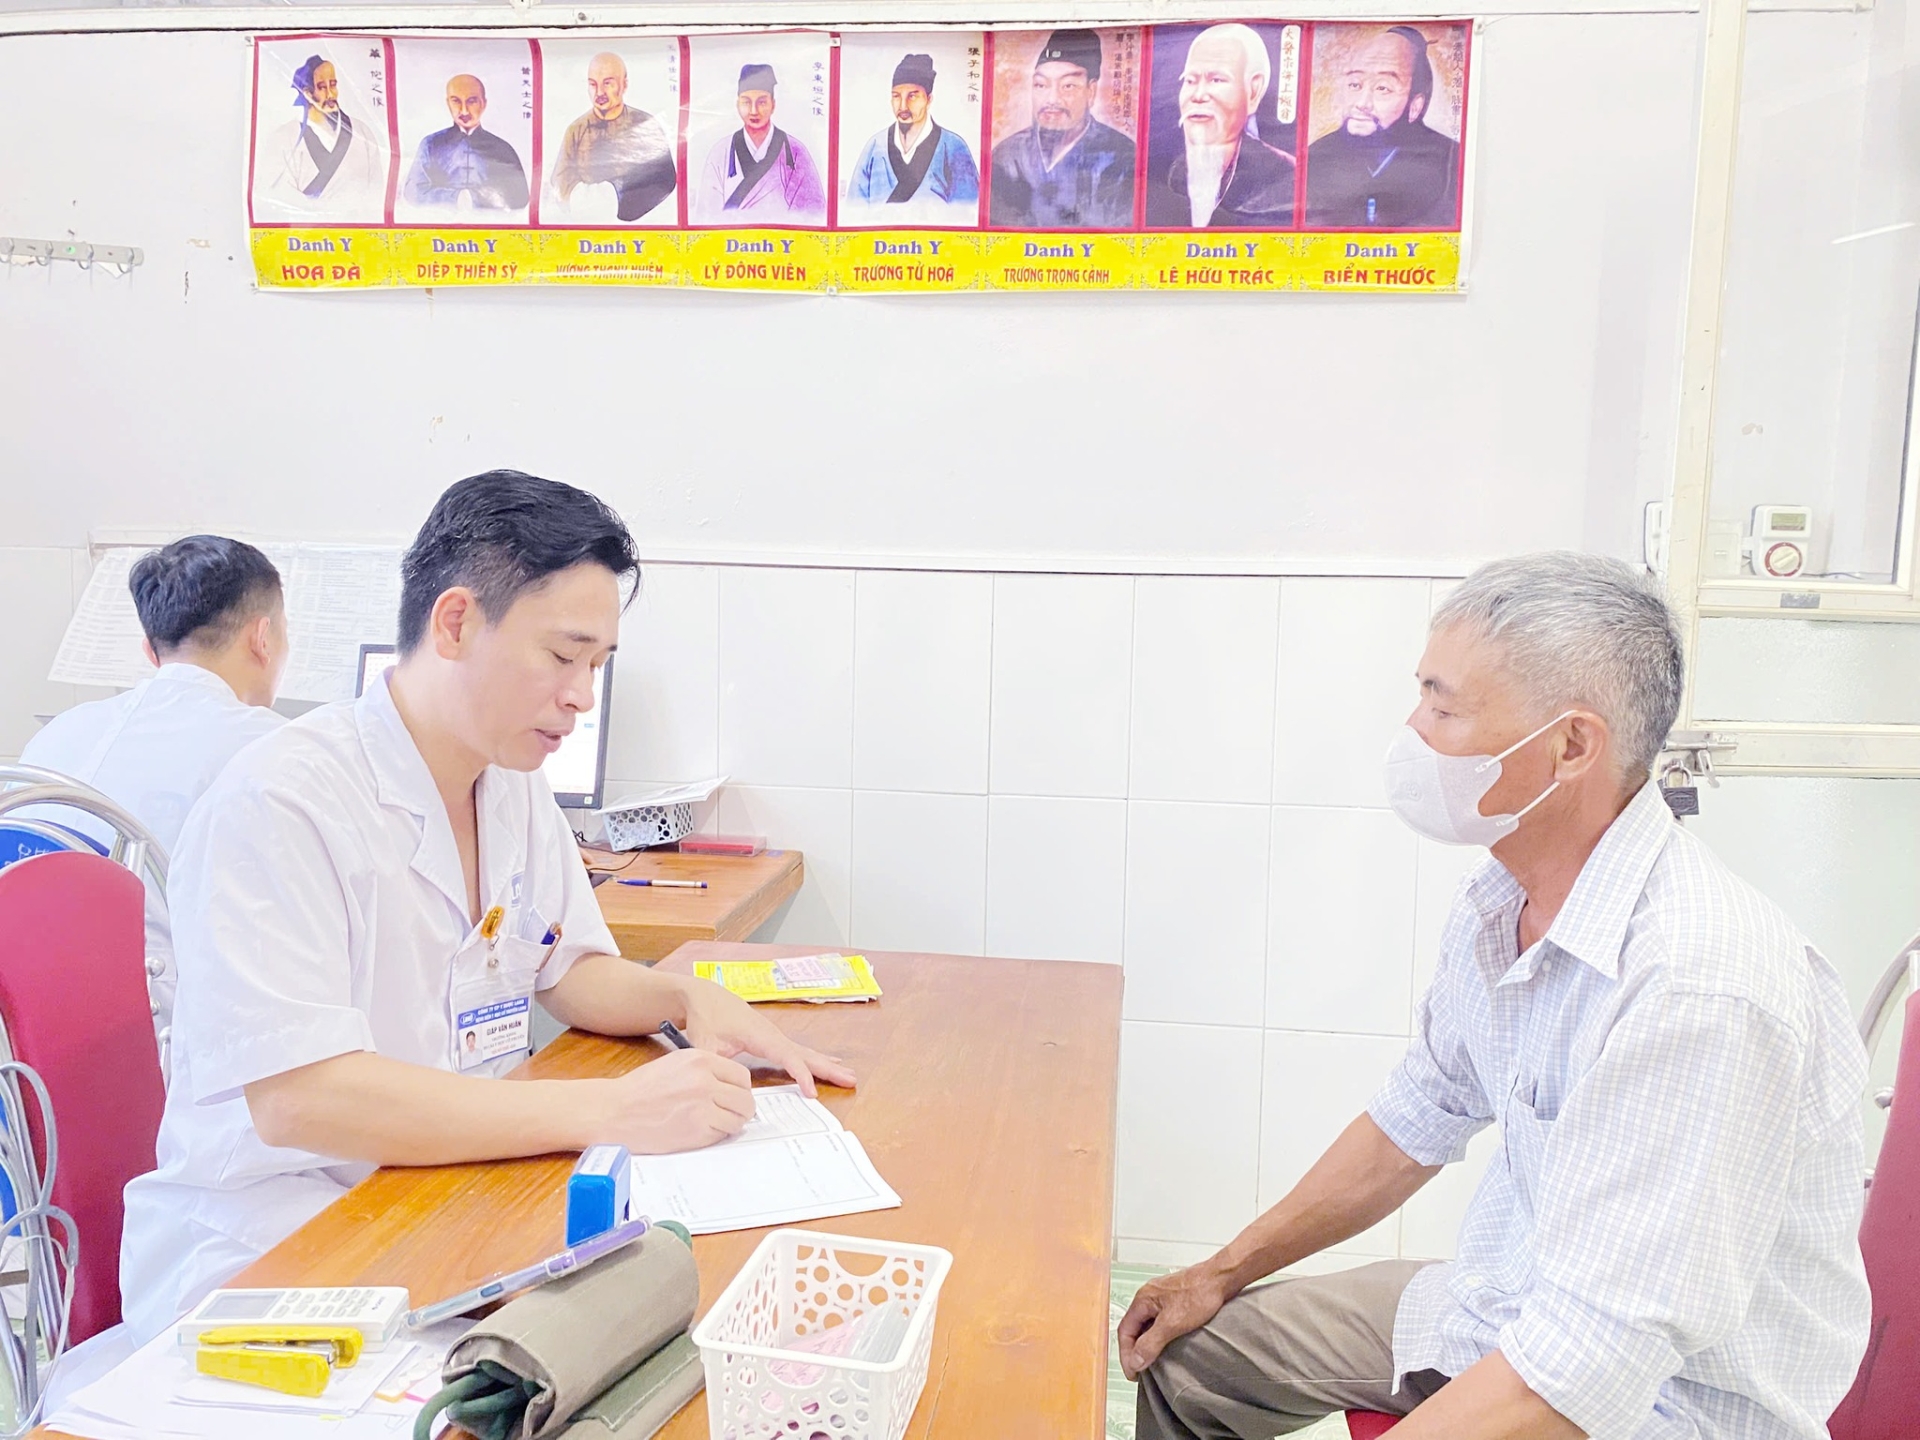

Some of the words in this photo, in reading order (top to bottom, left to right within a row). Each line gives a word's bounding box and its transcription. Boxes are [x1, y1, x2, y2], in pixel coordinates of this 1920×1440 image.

[288, 237, 335, 252] Danh
[339, 237, 353, 252] Y
[432, 238, 479, 253] Danh
[484, 239, 498, 253] Y
[579, 239, 627, 254] Danh
[632, 239, 645, 254] Y
[725, 239, 774, 253] Danh
[780, 239, 794, 254] Y
[874, 240, 923, 255] Danh
[929, 240, 943, 255] Y
[1024, 242, 1074, 257] Danh
[1081, 243, 1095, 258] Y
[1186, 243, 1238, 258] Danh
[1245, 243, 1259, 258] Y
[1345, 243, 1398, 258] Danh
[1405, 242, 1420, 257] Y
[282, 265, 324, 281] HOA
[332, 262, 361, 280] ĐÀ
[417, 261, 450, 281] DIỆP
[456, 261, 498, 280] THIÊN
[704, 261, 721, 280] LÝ
[725, 260, 767, 279] ĐÔNG
[772, 262, 806, 281] VIÊN
[854, 264, 903, 283] TRƯƠNG
[907, 260, 924, 281] TỬ
[928, 263, 954, 282] HOÀ
[1004, 266, 1043, 284] TRƯƠNG
[1046, 268, 1080, 285] TRỌNG
[1082, 264, 1110, 284] CẢNH
[1160, 266, 1179, 283] LÊ
[1186, 266, 1222, 284] HỮU
[1228, 266, 1274, 285] TRÁC
[1324, 262, 1368, 284] BIỂN
[1374, 265, 1436, 285] THƯỚC
